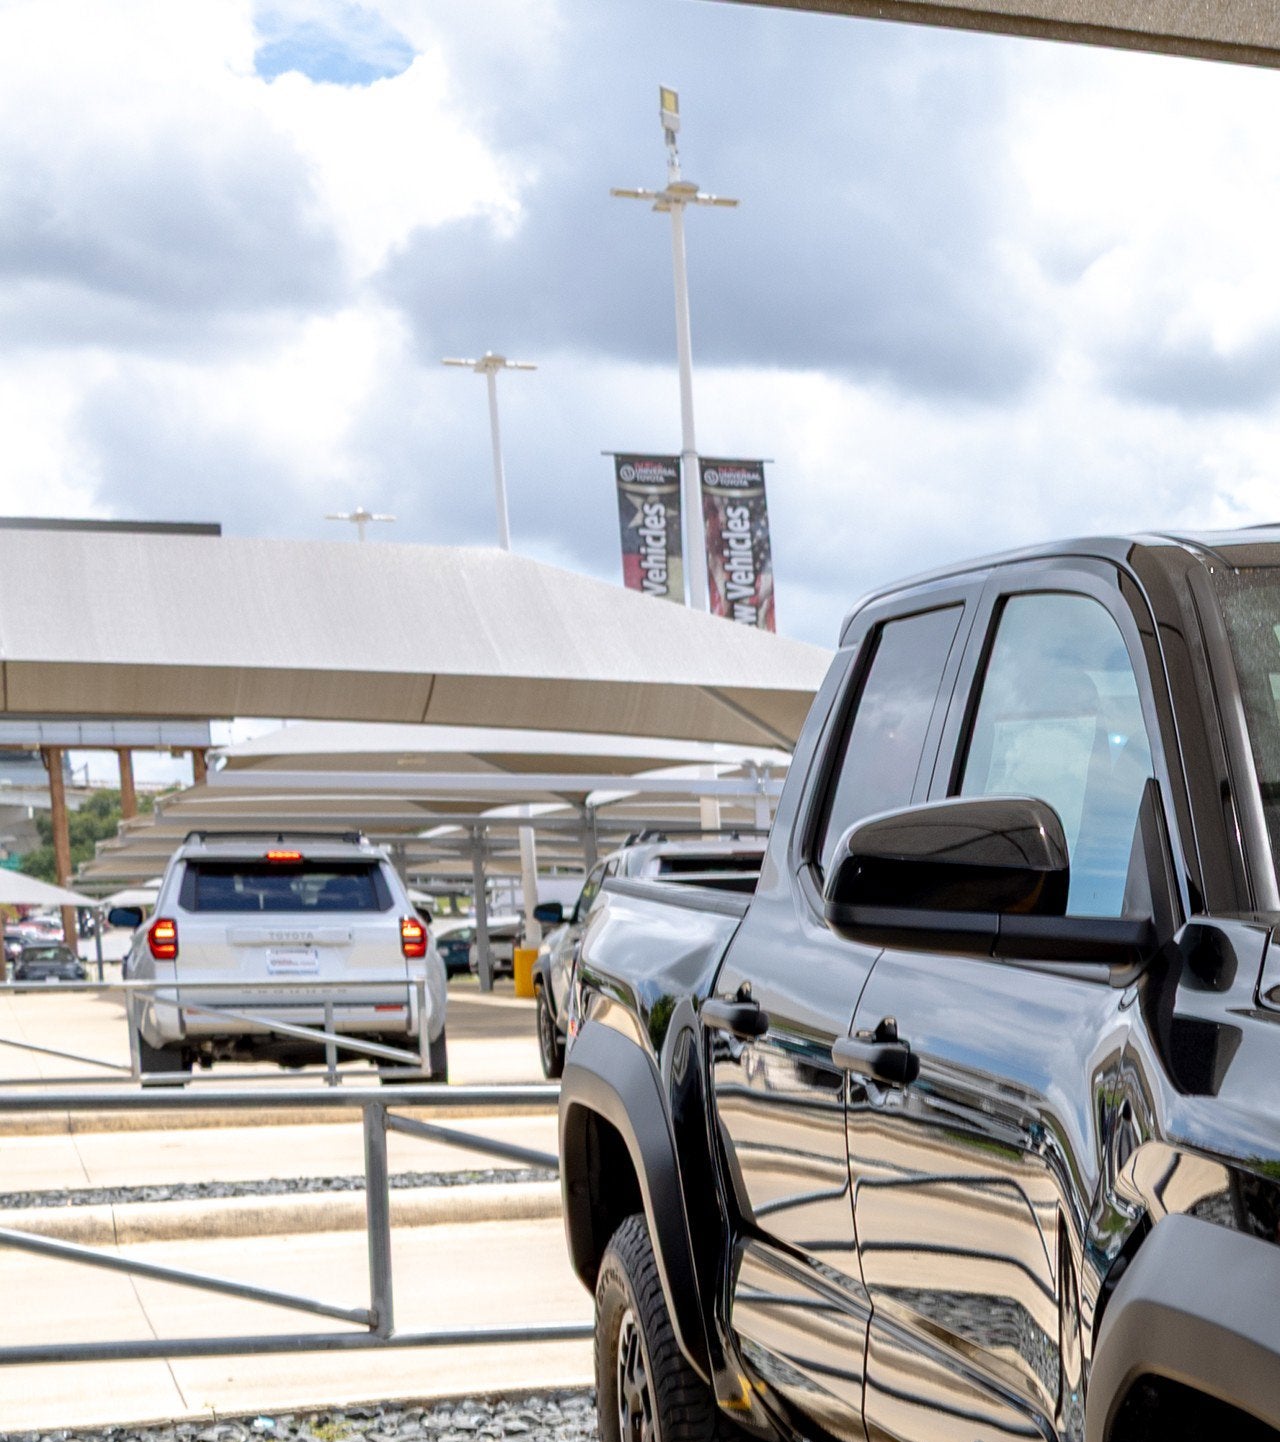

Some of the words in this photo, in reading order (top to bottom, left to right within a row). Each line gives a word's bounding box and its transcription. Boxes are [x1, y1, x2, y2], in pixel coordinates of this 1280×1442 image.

[636, 475, 664, 483] TOYOTA
[720, 480, 749, 488] TOYOTA
[721, 505, 756, 601] Vehicles
[267, 931, 315, 940] TOYOTA
